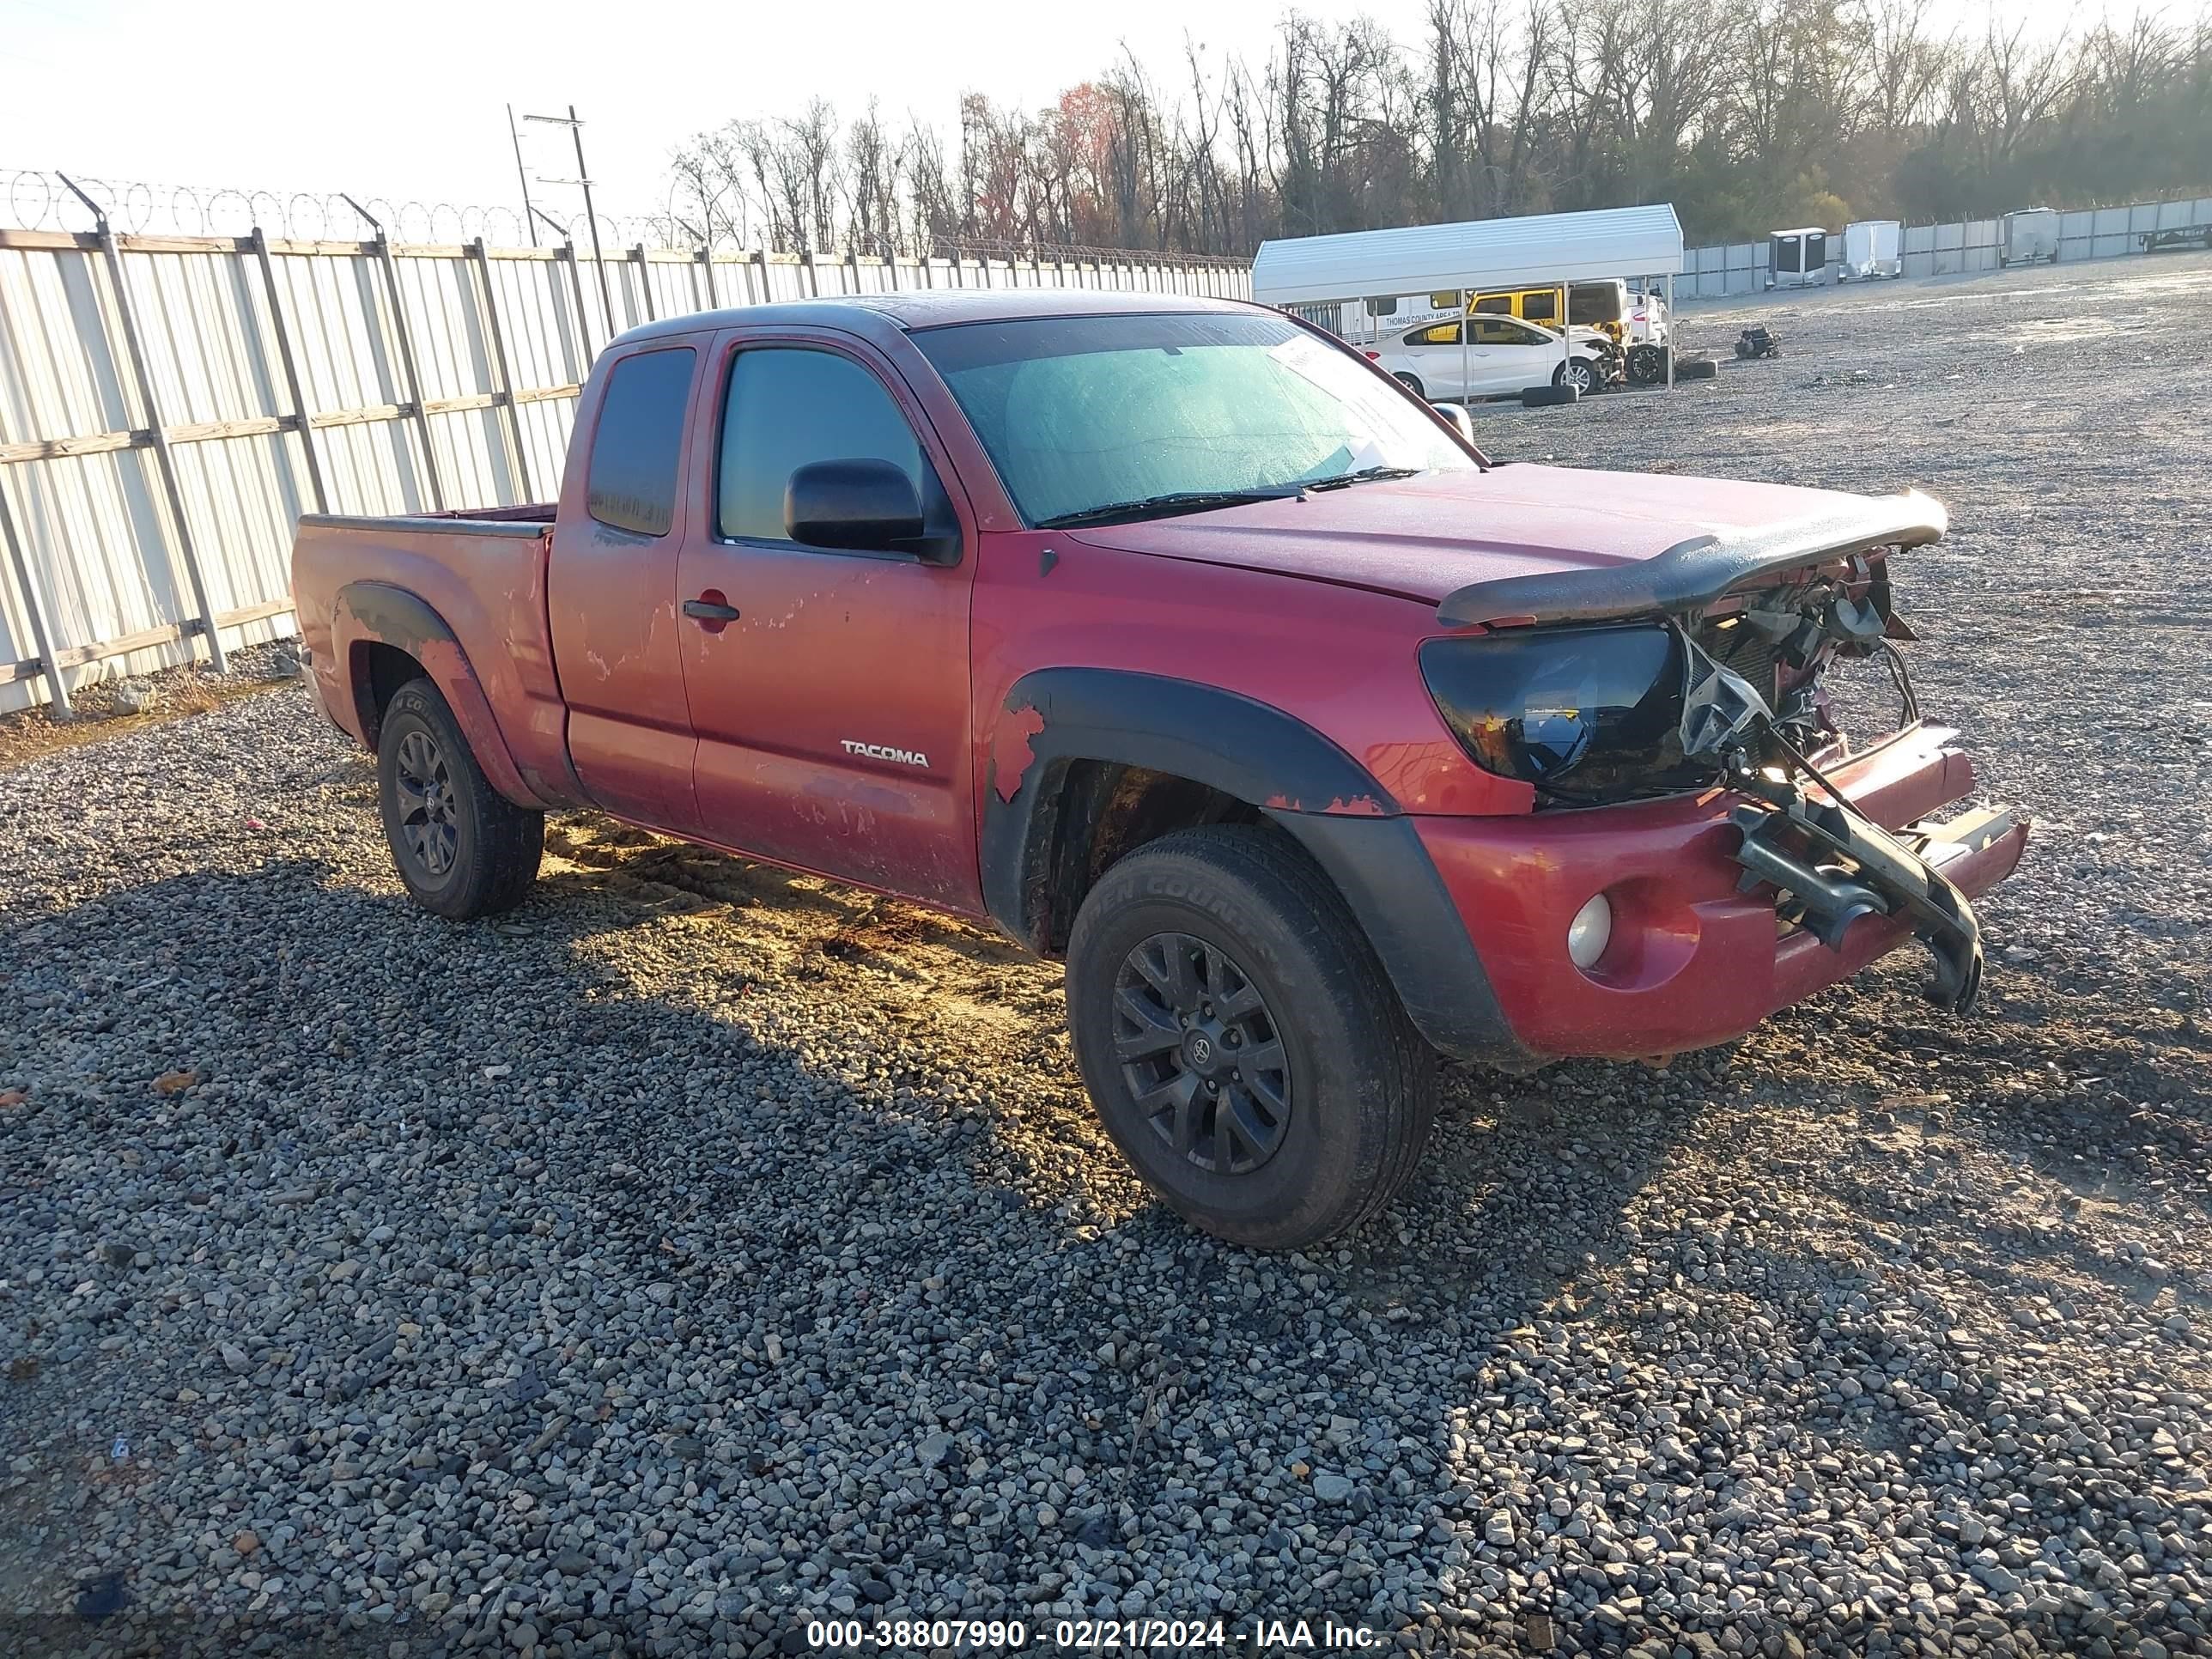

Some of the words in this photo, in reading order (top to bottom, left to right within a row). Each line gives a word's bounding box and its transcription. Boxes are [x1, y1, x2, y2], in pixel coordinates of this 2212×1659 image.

[1386, 316, 1410, 326] THOMAS
[1411, 313, 1434, 324] COUNTY
[840, 740, 929, 769] TACOMA
